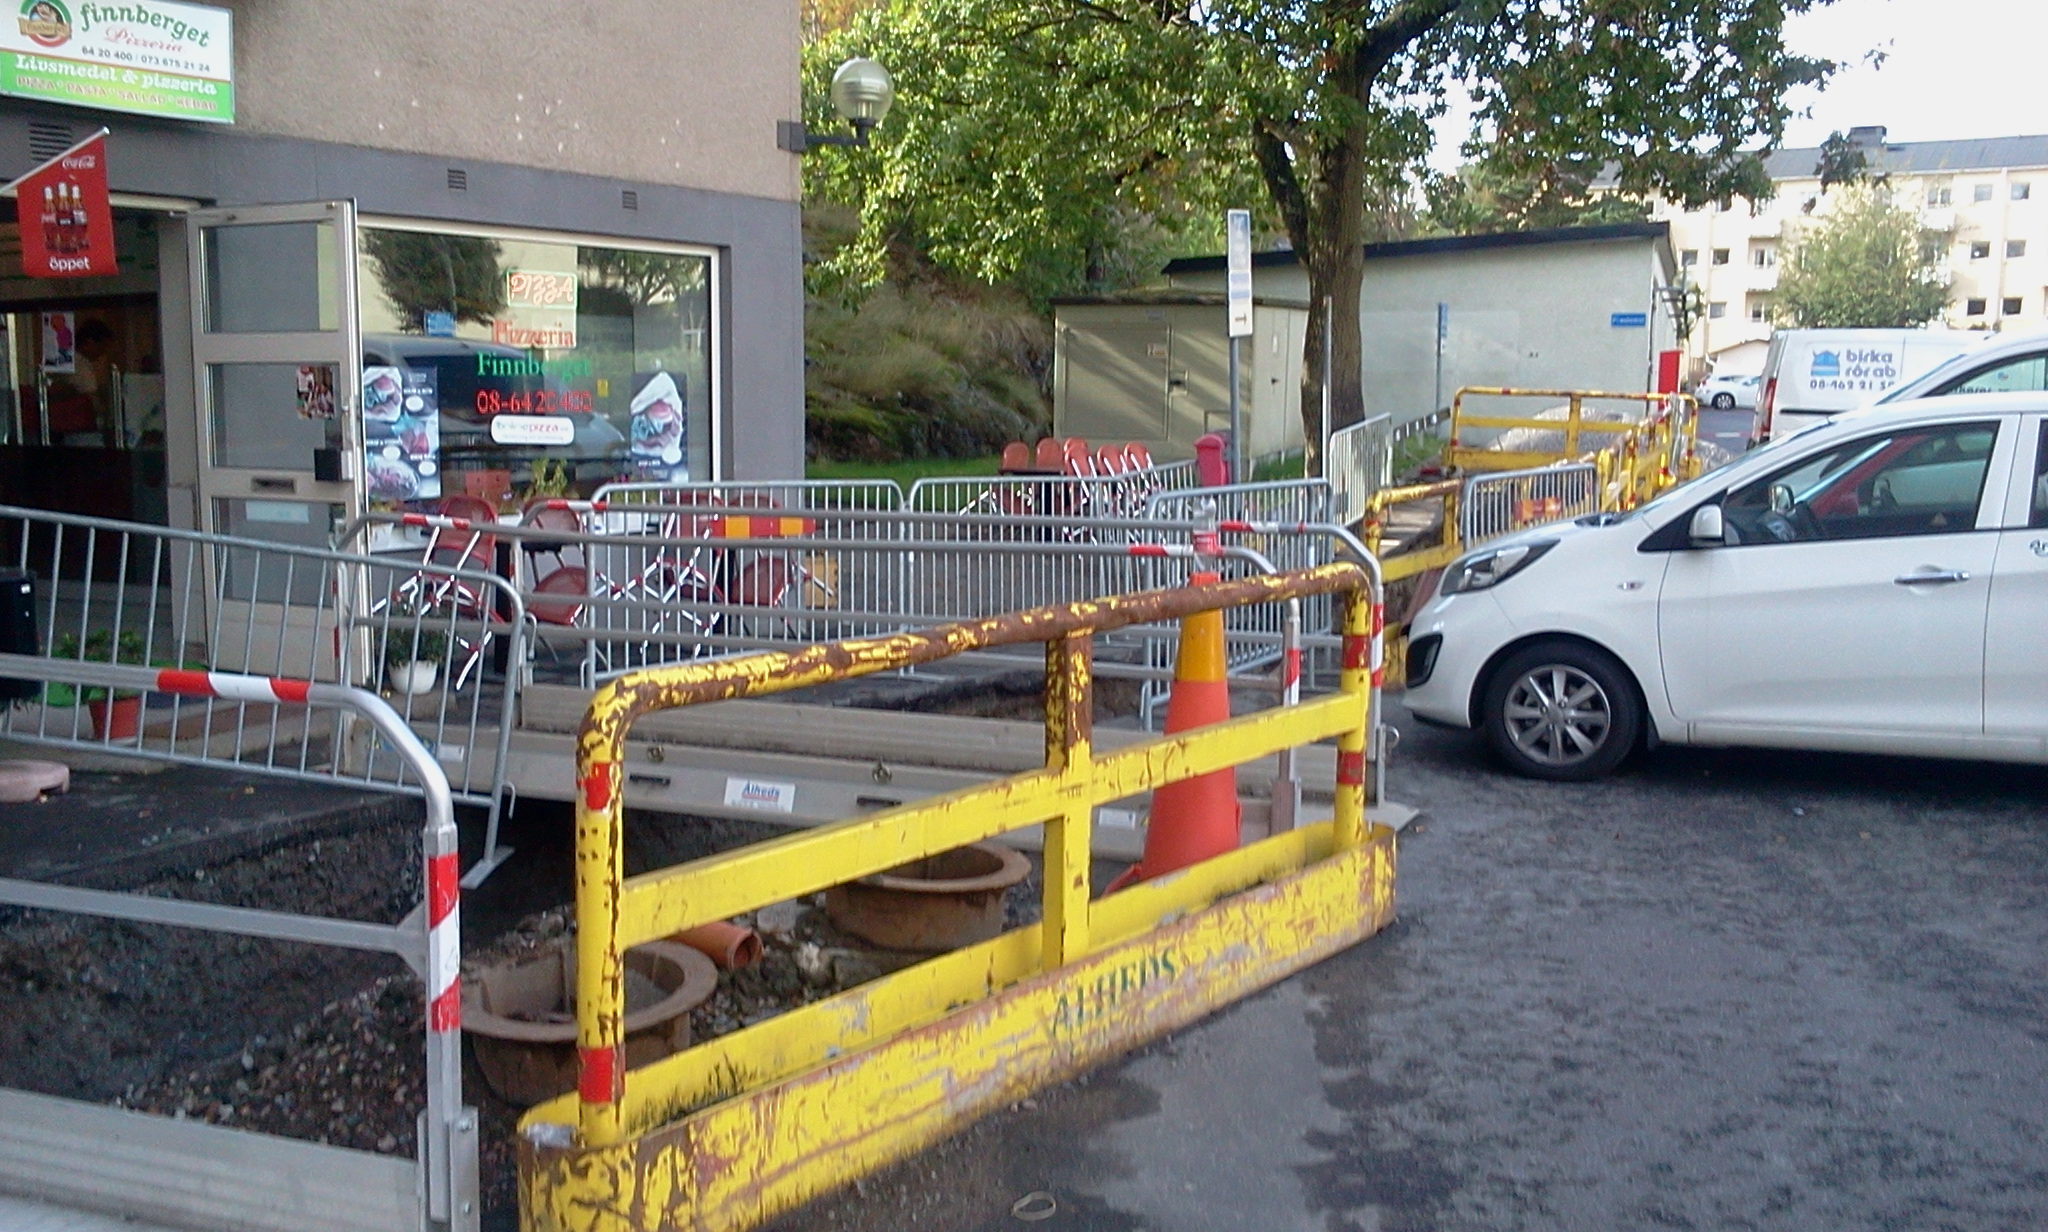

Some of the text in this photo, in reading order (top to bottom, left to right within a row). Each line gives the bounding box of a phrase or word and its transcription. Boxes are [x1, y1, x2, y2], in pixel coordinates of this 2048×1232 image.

[80, 3, 209, 47] finnberget
[99, 48, 111, 58] 20
[114, 50, 133, 61] 400
[141, 55, 160, 65] 073
[15, 54, 218, 95] Livsmedel & pizzeria
[49, 256, 91, 272] öppet
[510, 273, 574, 304] PIZZA
[1846, 348, 1893, 363] birka
